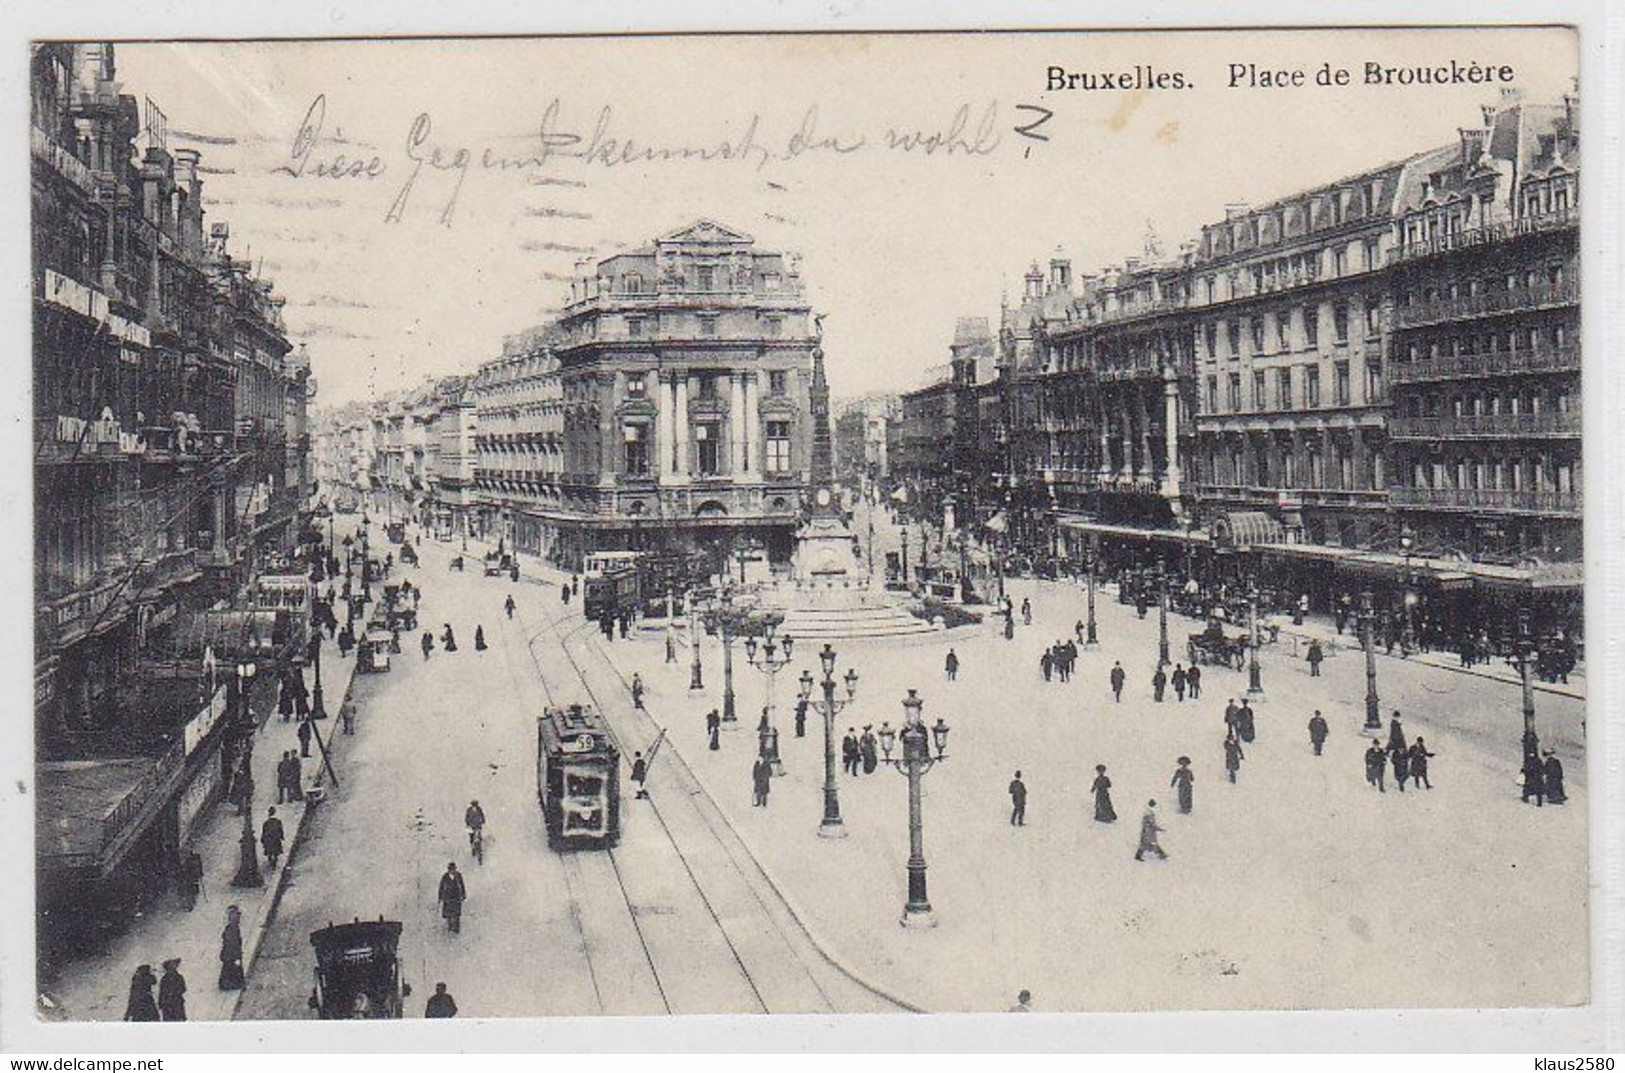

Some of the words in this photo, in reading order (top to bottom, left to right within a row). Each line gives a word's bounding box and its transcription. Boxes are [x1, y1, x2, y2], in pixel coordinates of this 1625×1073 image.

[270, 93, 386, 179] Diese
[384, 97, 584, 228] Gegend
[884, 98, 1001, 156] wohl
